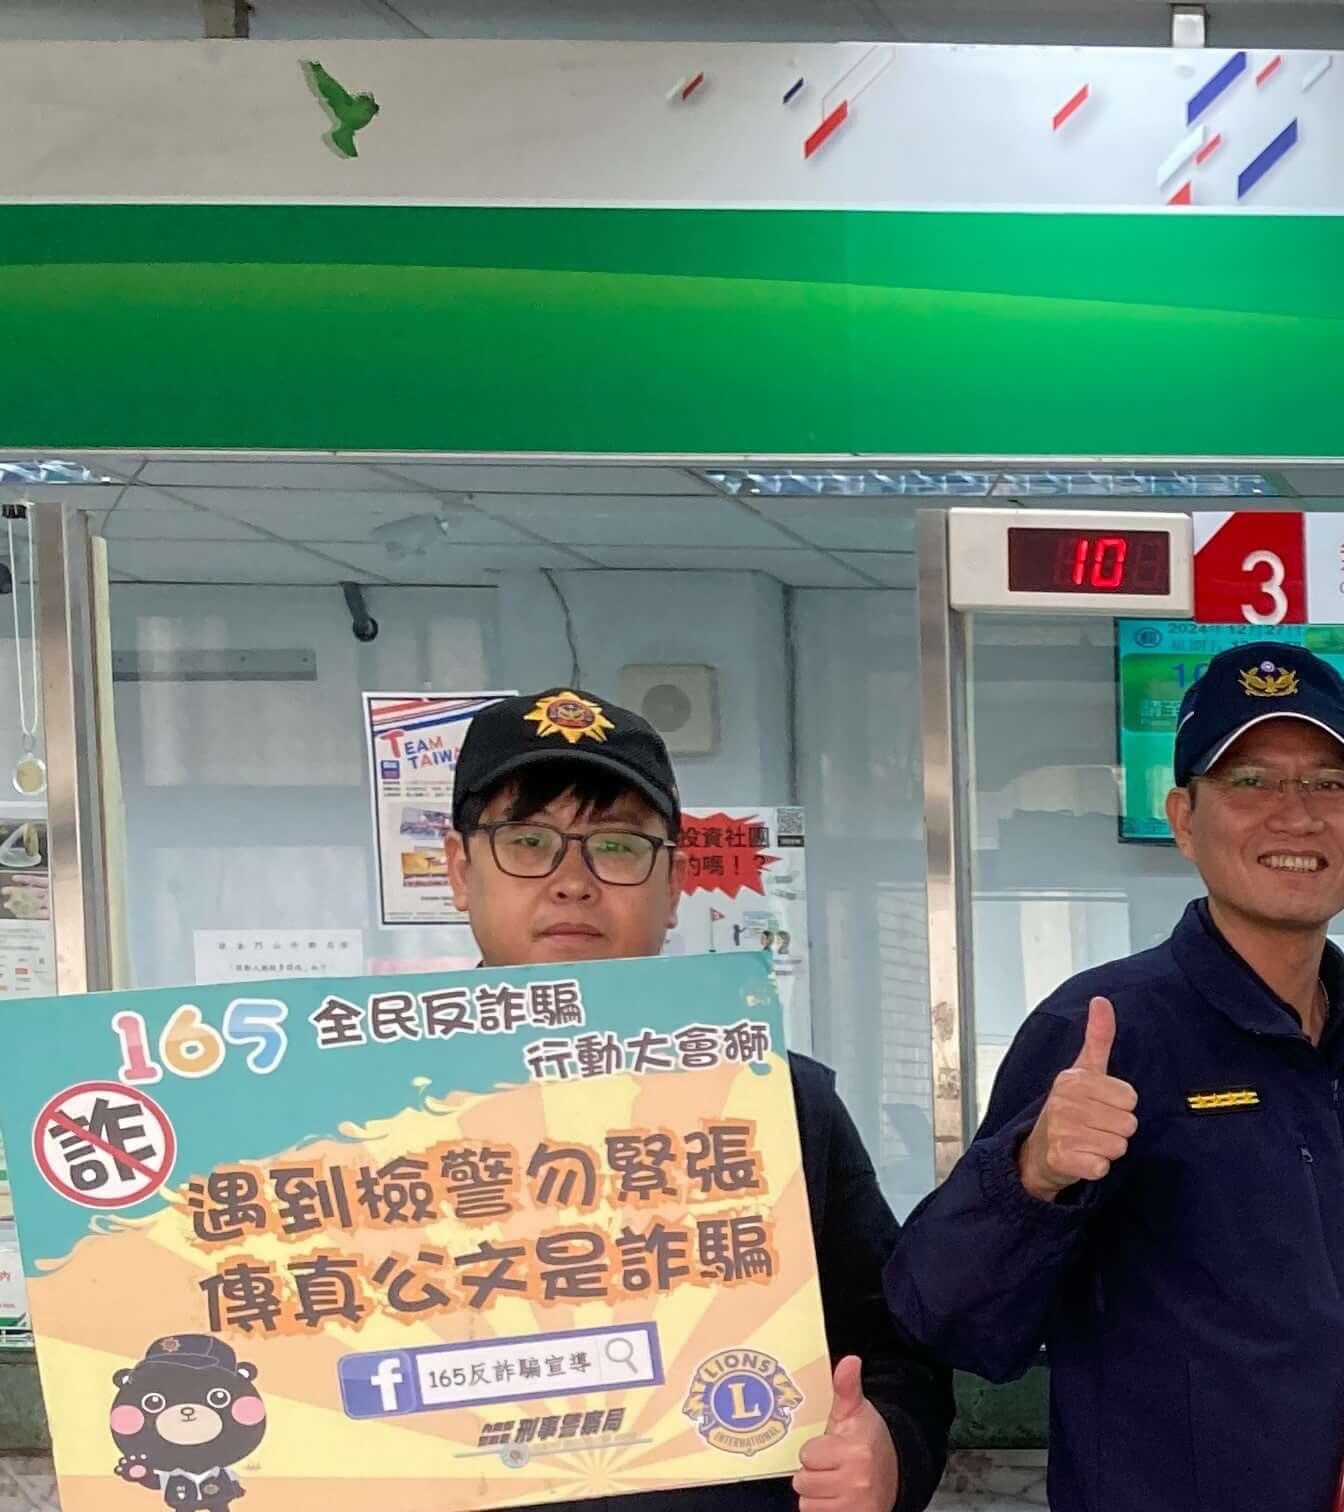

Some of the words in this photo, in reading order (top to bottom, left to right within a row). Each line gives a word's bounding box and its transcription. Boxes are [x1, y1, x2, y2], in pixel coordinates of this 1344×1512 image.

[1072, 536, 1127, 589] 10
[1241, 550, 1287, 624] 3
[379, 731, 443, 758] TEAM
[114, 999, 288, 1083] 165
[313, 981, 583, 1047] 全民反詐騙
[527, 1023, 769, 1078] 行動大會獅
[51, 1098, 158, 1190] 詐
[187, 1127, 760, 1242] 遇到檢警勿緊張
[200, 1216, 773, 1333] 傳真公文是詐騙
[428, 1352, 592, 1389] 165反詐騙宣導
[703, 1353, 771, 1379] LIONS
[728, 1382, 762, 1420] L
